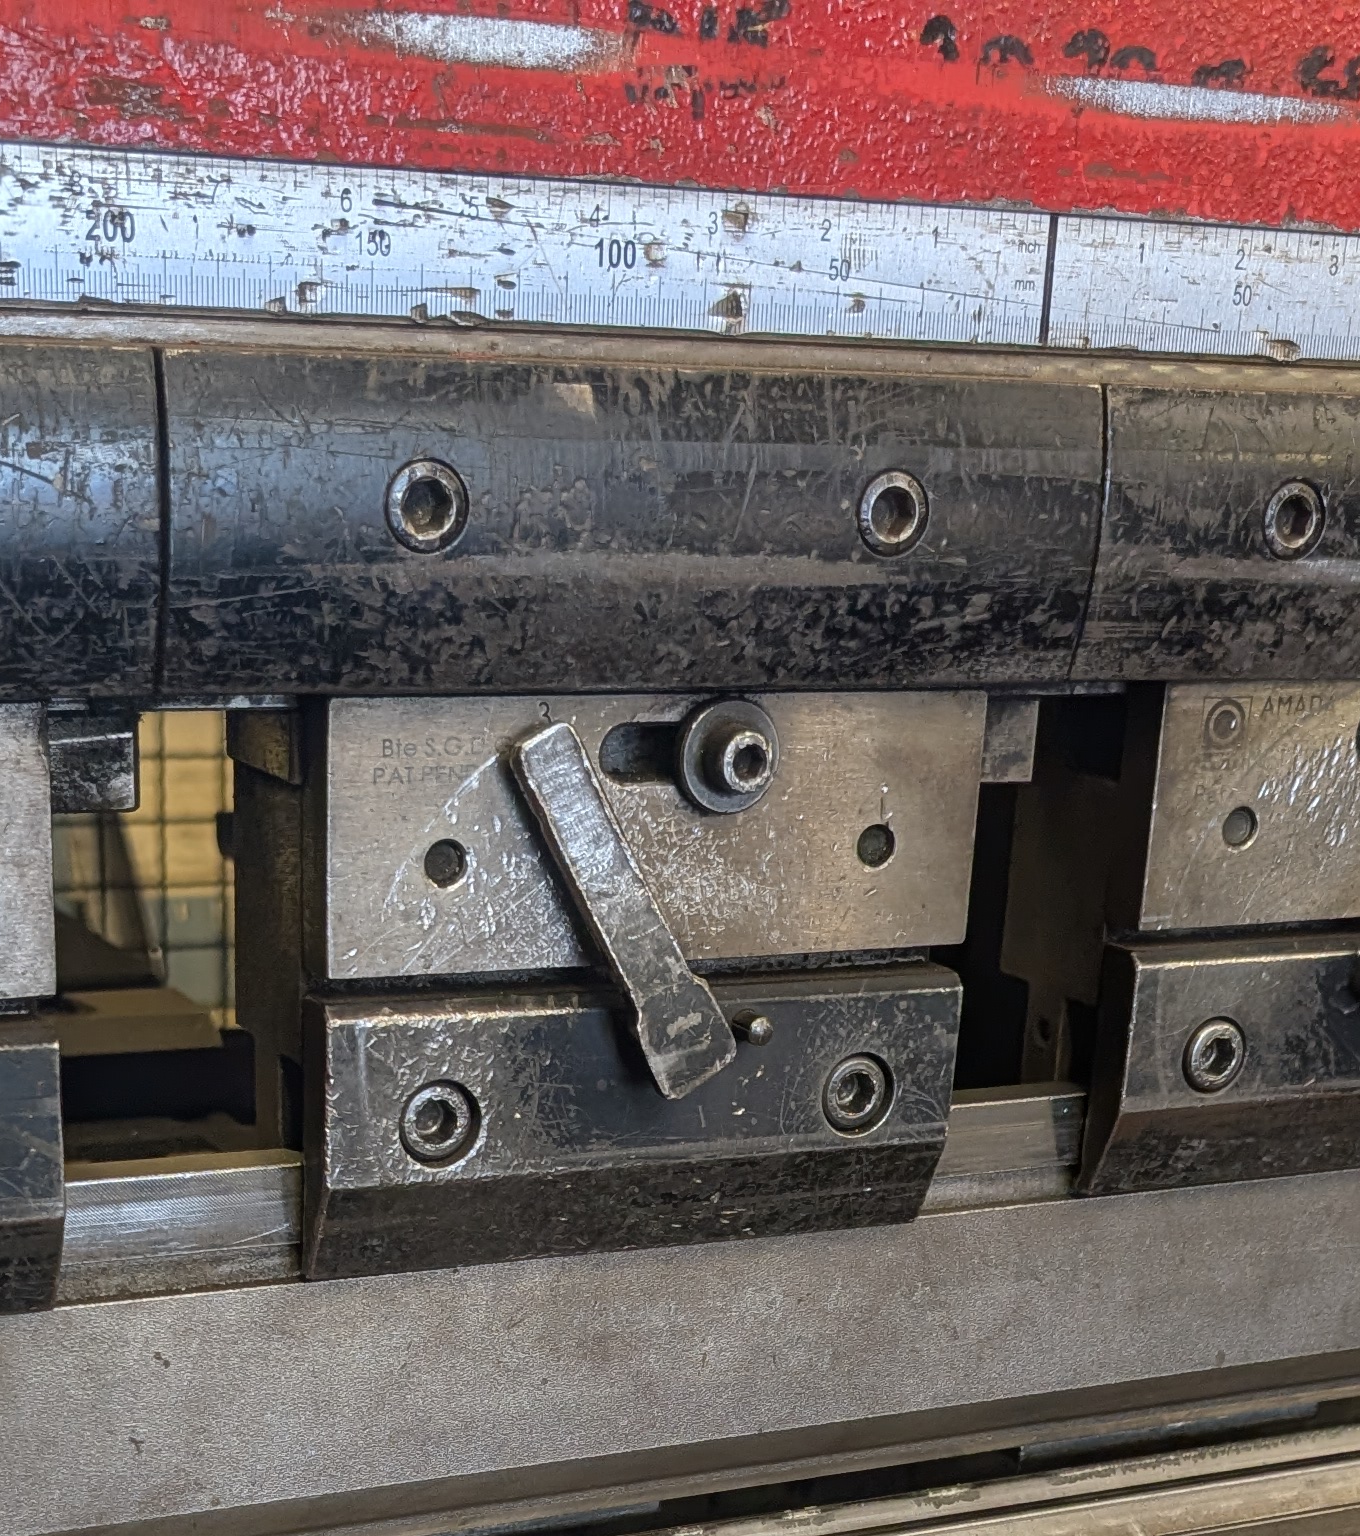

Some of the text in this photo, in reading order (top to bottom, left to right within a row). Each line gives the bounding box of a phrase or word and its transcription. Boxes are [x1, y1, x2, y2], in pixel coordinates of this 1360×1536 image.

[340, 187, 353, 213] 6
[589, 204, 601, 227] 4
[707, 212, 719, 235] 3
[821, 219, 832, 242] 2
[931, 226, 939, 248] 1
[85, 208, 136, 243] 200
[355, 230, 392, 258] 150
[594, 238, 637, 269] 100
[828, 259, 850, 282] 50
[1014, 276, 1036, 292] mm
[1138, 243, 1145, 265] 1
[1234, 250, 1246, 271] 2
[1328, 255, 1339, 277] 3
[1232, 284, 1252, 308] 50
[372, 766, 413, 785] PAT
